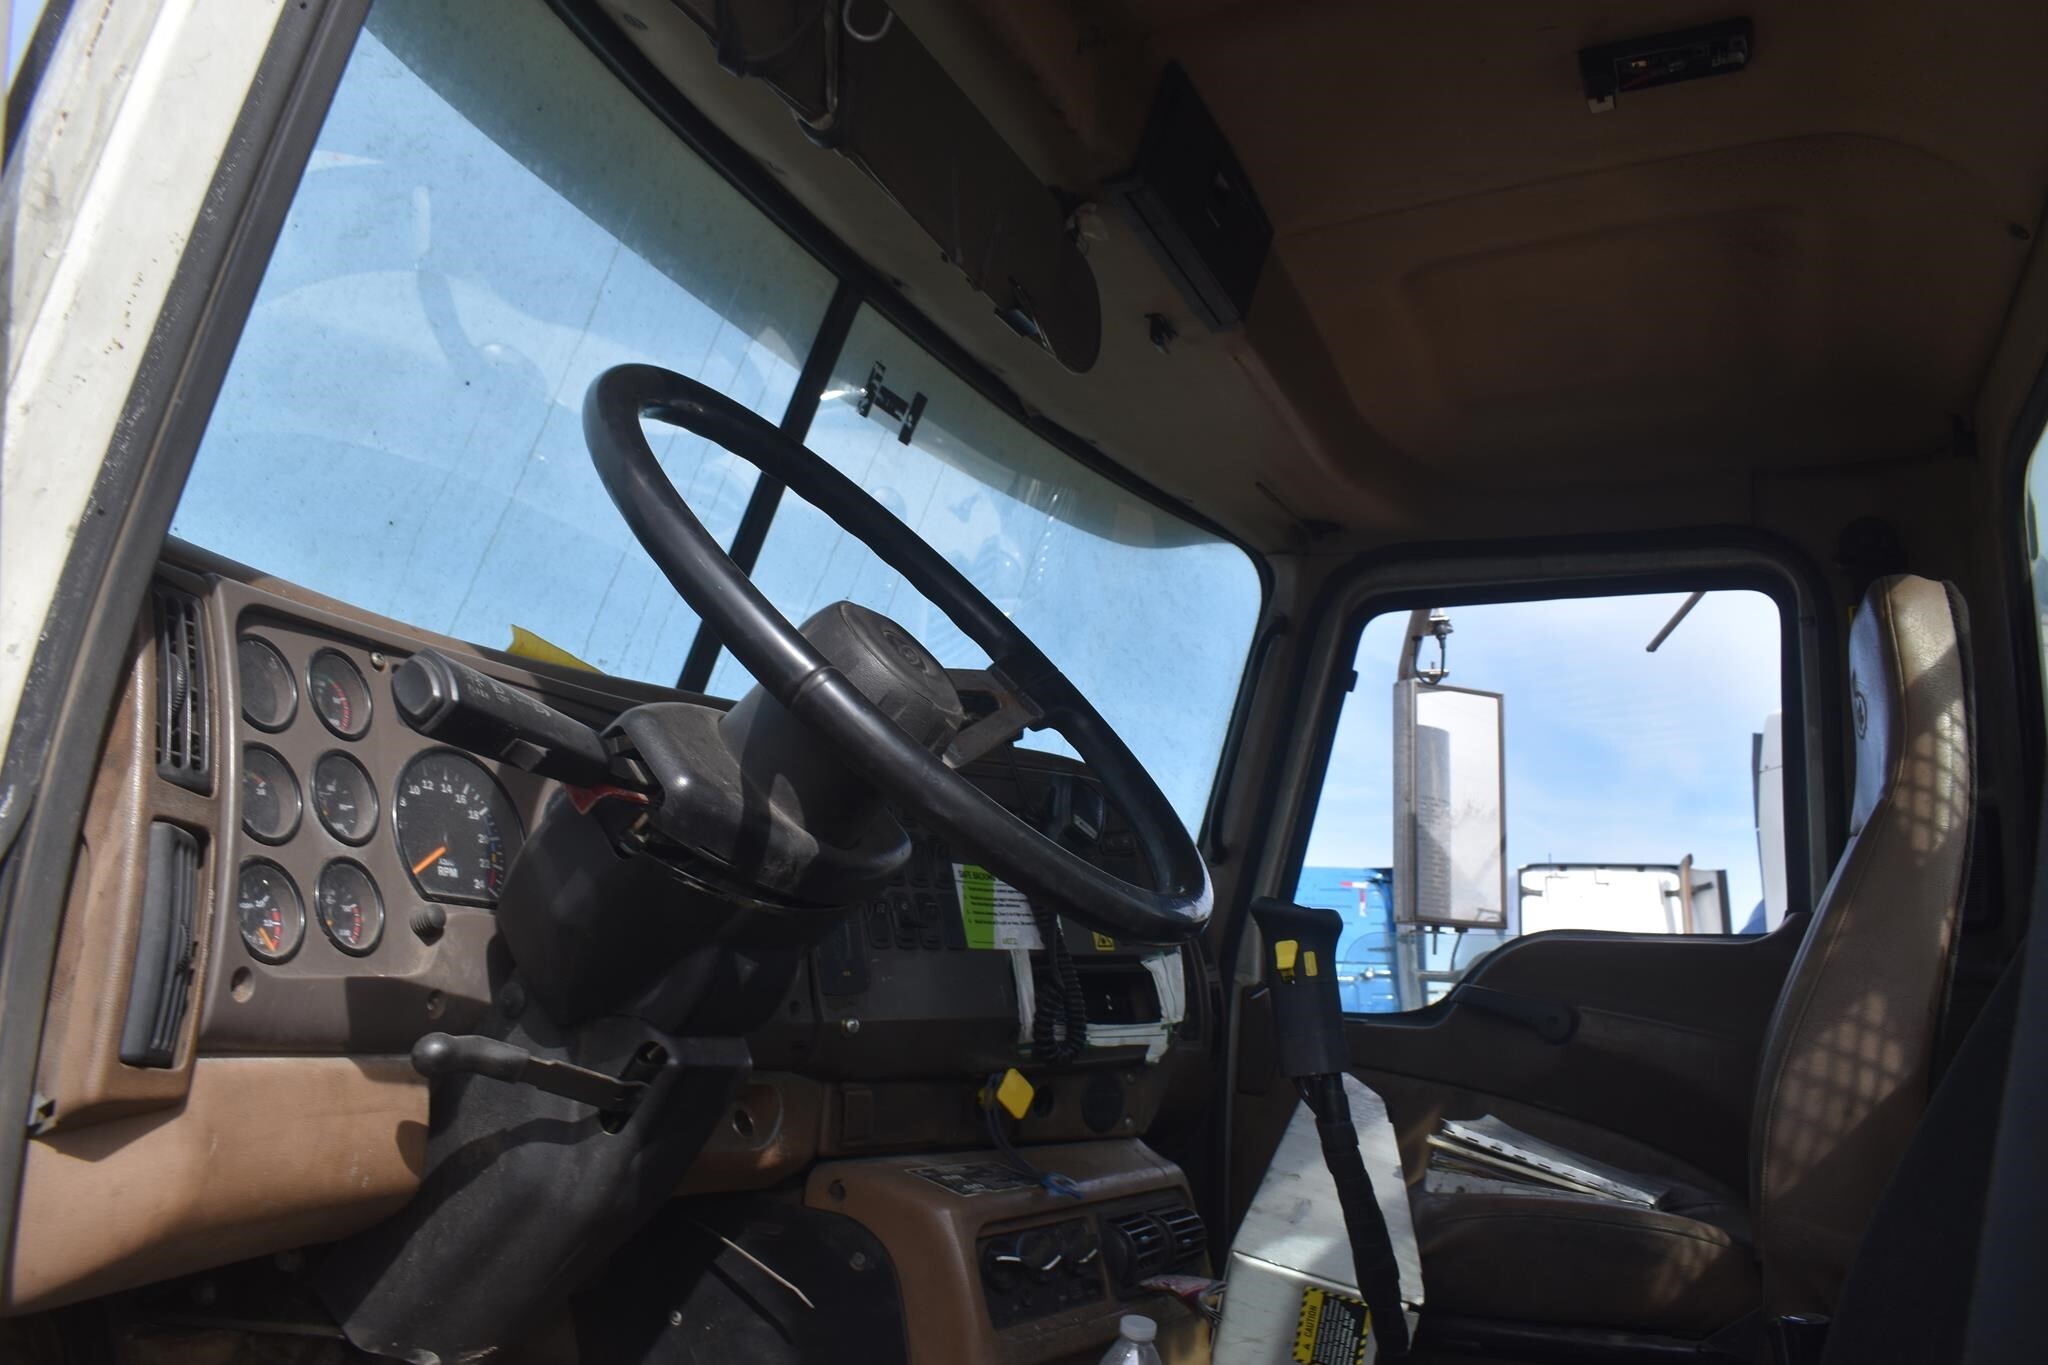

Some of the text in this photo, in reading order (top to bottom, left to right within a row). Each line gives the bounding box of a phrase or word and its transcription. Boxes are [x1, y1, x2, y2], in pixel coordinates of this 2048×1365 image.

[408, 785, 421, 795] 10
[422, 780, 434, 791] 12
[440, 784, 453, 794] 14
[437, 866, 459, 878] RPM
[1304, 1305, 1317, 1338] CAUTION
